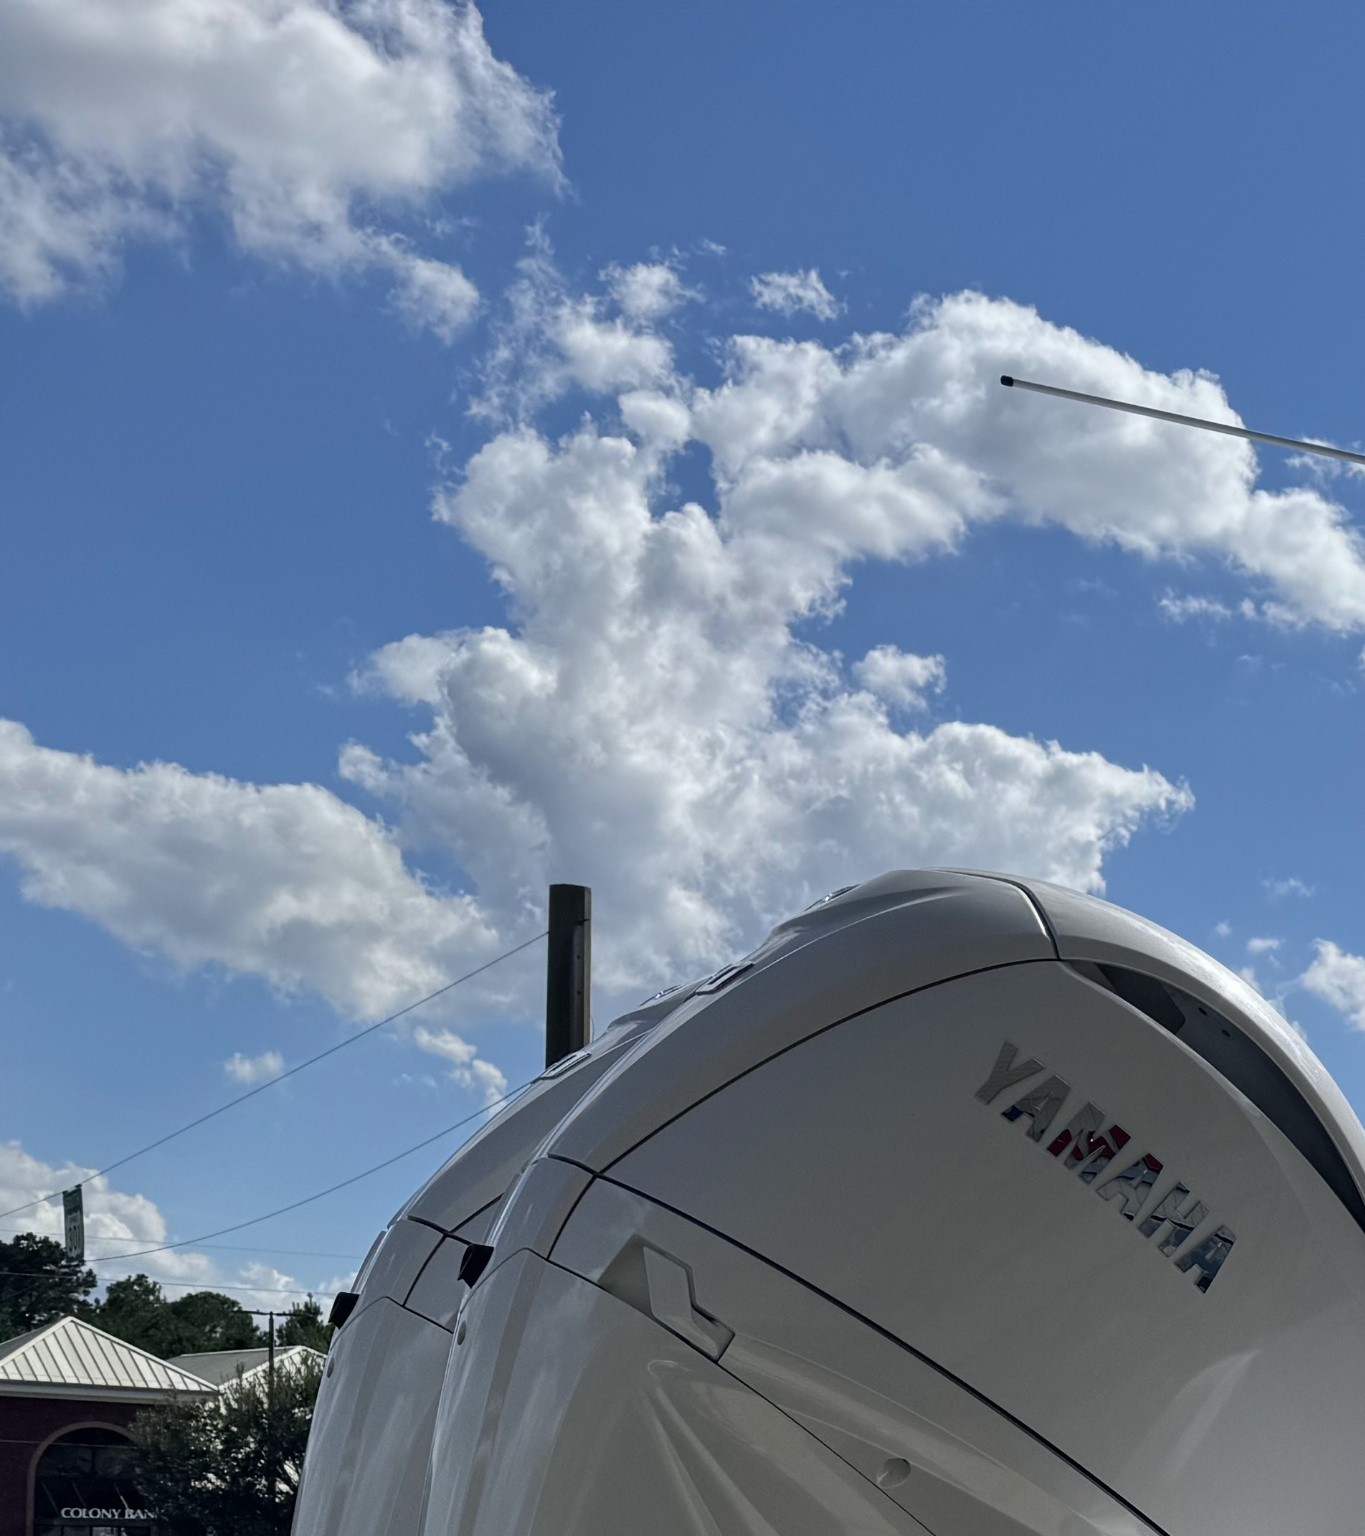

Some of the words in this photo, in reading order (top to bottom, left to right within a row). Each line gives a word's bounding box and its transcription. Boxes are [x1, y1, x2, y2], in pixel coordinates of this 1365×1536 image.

[973, 1039, 1238, 1294] YAMAHA
[60, 1507, 120, 1519] COLONY
[124, 1508, 158, 1519] BAN
